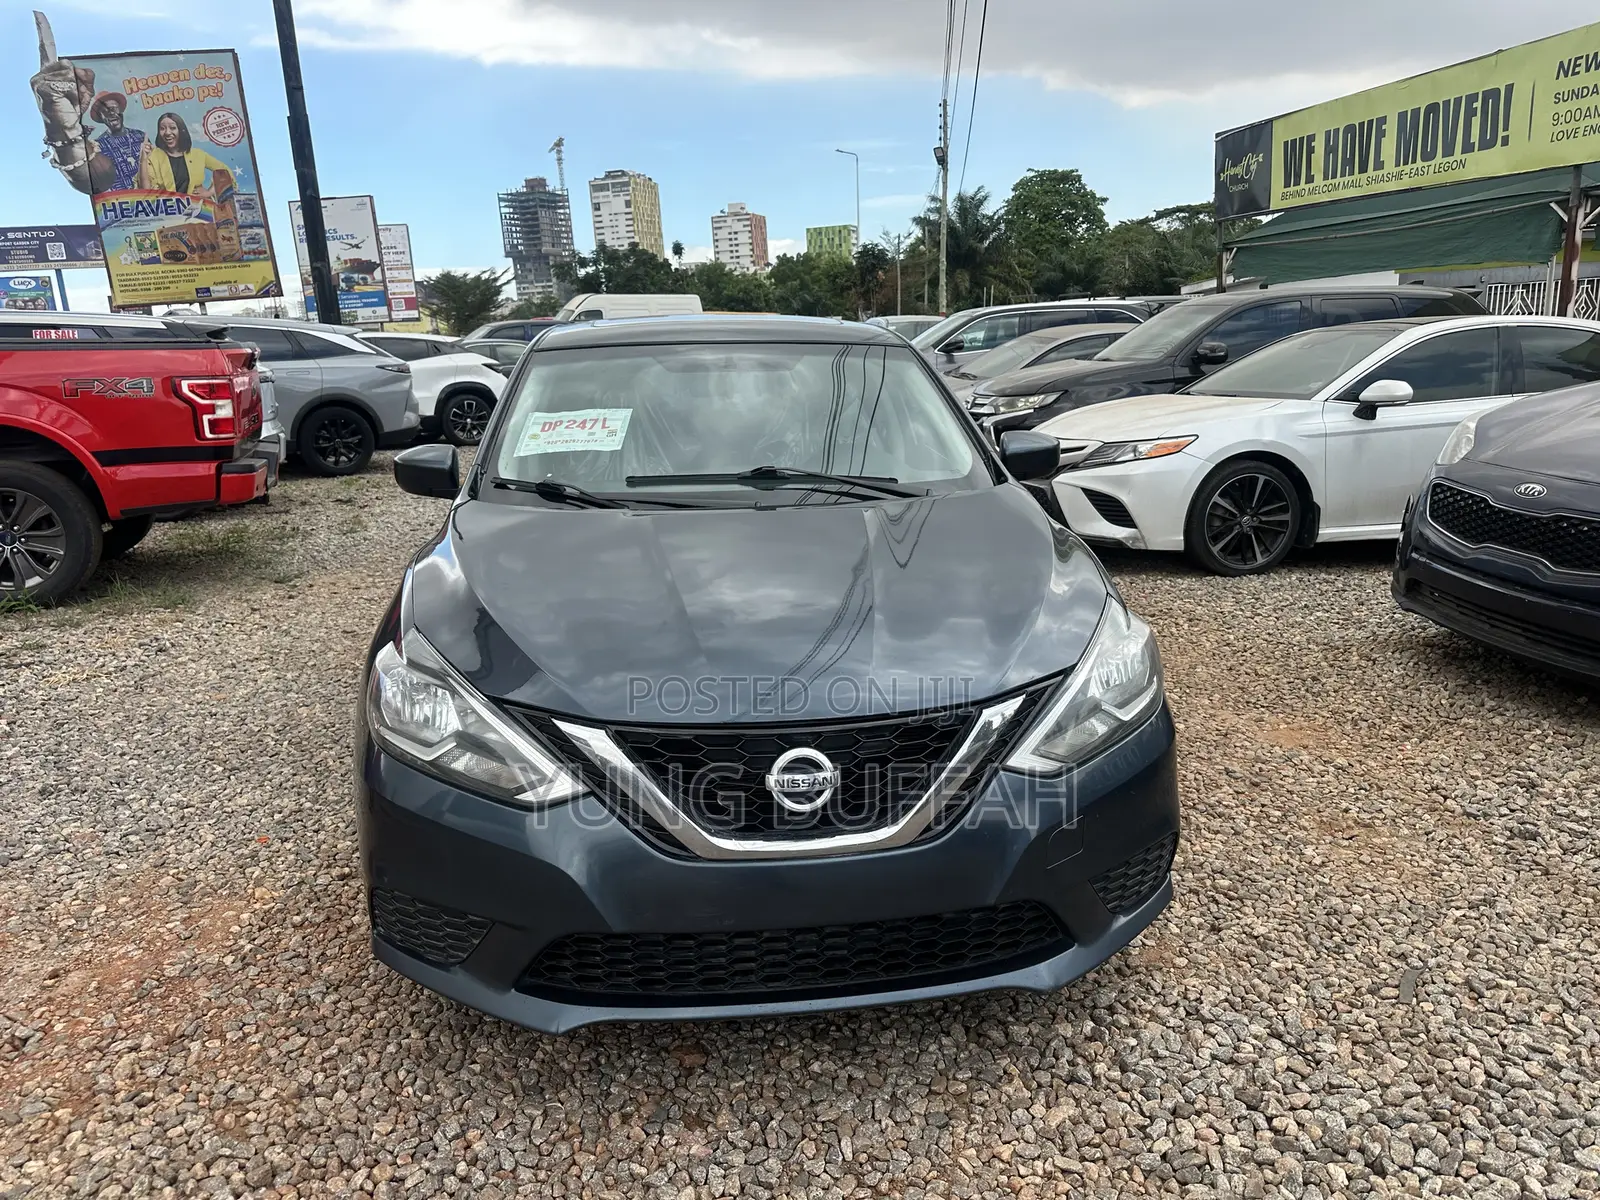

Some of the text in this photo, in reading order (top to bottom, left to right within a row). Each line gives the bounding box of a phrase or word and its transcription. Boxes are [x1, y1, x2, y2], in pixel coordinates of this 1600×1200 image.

[1555, 51, 1600, 80] NEW
[123, 68, 191, 95] Heaven
[141, 85, 195, 109] baako
[1553, 83, 1600, 104] SUNDA
[212, 122, 240, 136] PERFUME
[216, 119, 230, 129] NEW
[1283, 82, 1515, 189] WE HAVE MOVED!
[1550, 127, 1580, 143] LOVE
[1280, 158, 1467, 201] BEHIND MELCOM MALL, SHIASHIE-EAST LEGON
[1229, 183, 1249, 193] CHURCH
[101, 196, 192, 222] HEAVEN
[7, 231, 55, 239] SENTUO
[326, 233, 358, 242] ESULTS.
[33, 330, 78, 339] FOR SALE
[61, 377, 156, 398] FX4
[540, 417, 610, 433] DP 247 L
[1516, 483, 1543, 496] KIA
[773, 775, 833, 789] NISSAN
